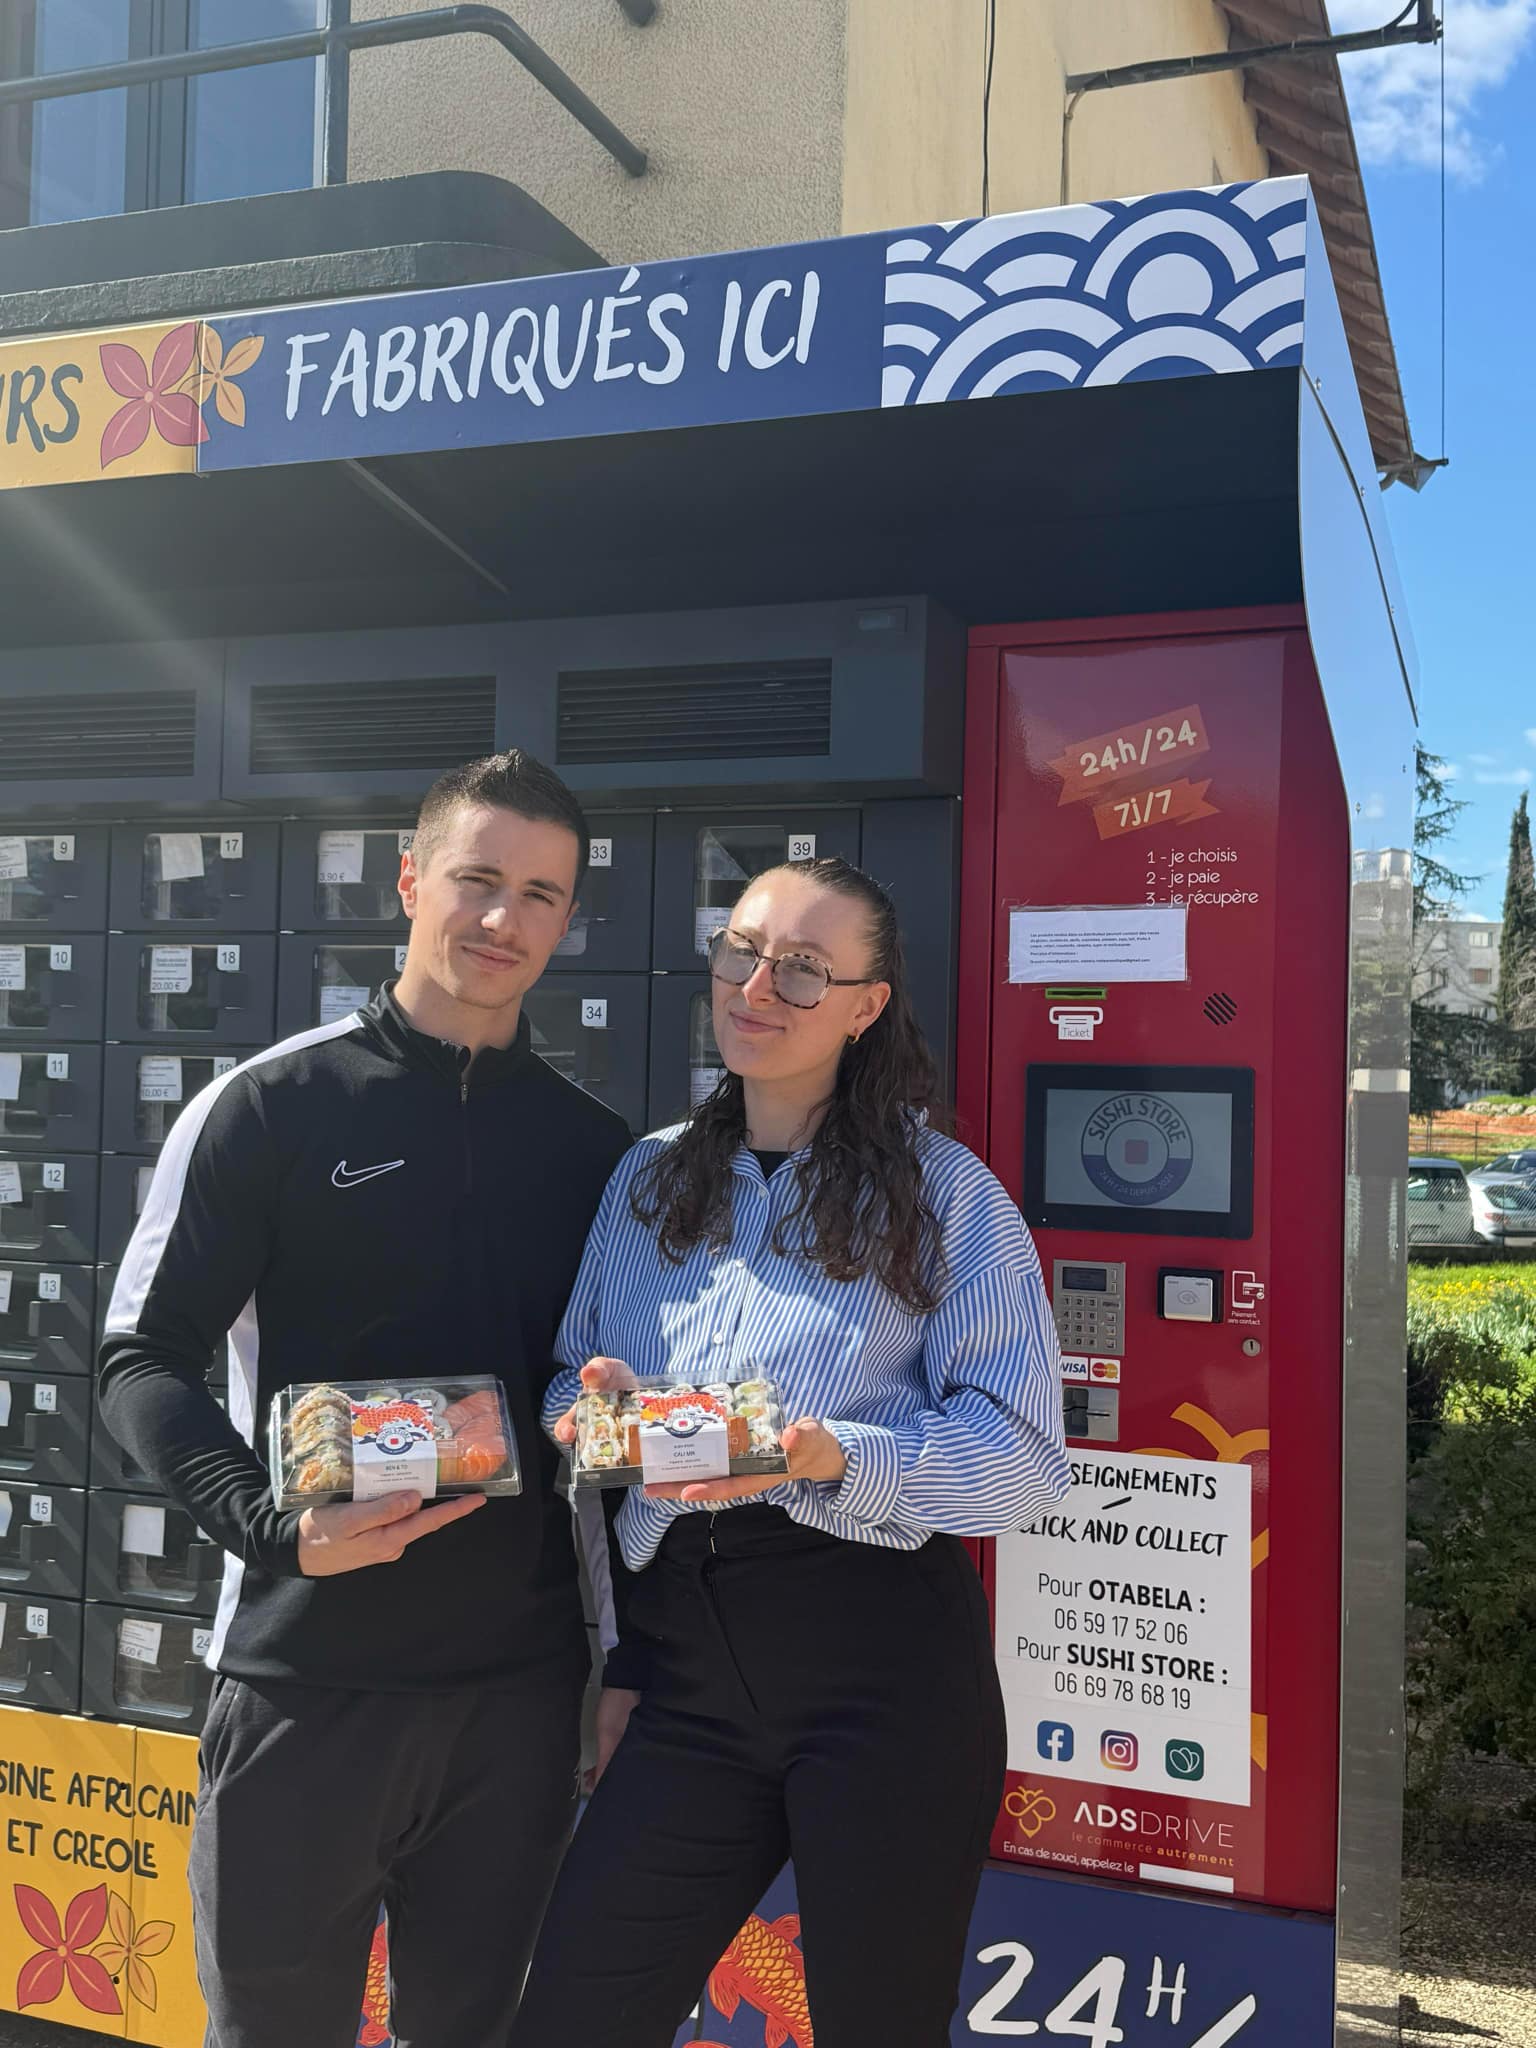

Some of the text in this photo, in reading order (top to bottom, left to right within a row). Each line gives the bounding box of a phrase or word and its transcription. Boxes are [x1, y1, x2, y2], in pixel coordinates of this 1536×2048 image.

[286, 266, 820, 420] FABRIQUÉS ICI
[0, 364, 83, 452] RS
[1079, 719, 1198, 777] 24h/24
[1113, 788, 1172, 828] 7j/7
[60, 841, 68, 854] 9
[225, 839, 239, 852] 17
[402, 836, 414, 849] 2
[591, 846, 608, 859] 33
[793, 842, 811, 856] 39
[1147, 851, 1156, 864] 1
[1168, 848, 1185, 867] je
[1188, 847, 1238, 863] choisis
[1146, 872, 1156, 885] 2
[1167, 869, 1184, 888] je
[1188, 868, 1221, 888] paie
[1145, 892, 1156, 907] 3
[1167, 890, 1184, 909] je
[1187, 889, 1260, 908] récupère
[56, 951, 68, 964] 10
[222, 951, 236, 964] 18
[586, 1006, 602, 1020] 34
[1063, 1027, 1091, 1038] Ticket
[51, 1058, 64, 1073] 11
[1088, 1098, 1187, 1144] SUSHI STORE
[47, 1169, 61, 1182] 12
[43, 1279, 57, 1293] 13
[1061, 1362, 1087, 1374] VISA
[39, 1390, 52, 1404] 14
[34, 1501, 48, 1515] 15
[1019, 1515, 1229, 1557] LICK AND COLLECT
[1038, 1573, 1083, 1598] Pour
[1088, 1579, 1193, 1612] OTABELA
[31, 1613, 44, 1627] 16
[1054, 1608, 1188, 1645] 06 59 17 52 06
[1017, 1636, 1061, 1661] Pour
[1066, 1643, 1135, 1672] SUSHI
[1141, 1653, 1215, 1683] STORE
[1054, 1671, 1191, 1710] 06 69 78 68 19
[1073, 1801, 1234, 1848] ADSDRIVE
[8, 1819, 158, 1879] ET CREOLE
[1003, 1841, 1135, 1873] En cas de souci, appelez le
[1072, 1831, 1234, 1867] le commerce autrement
